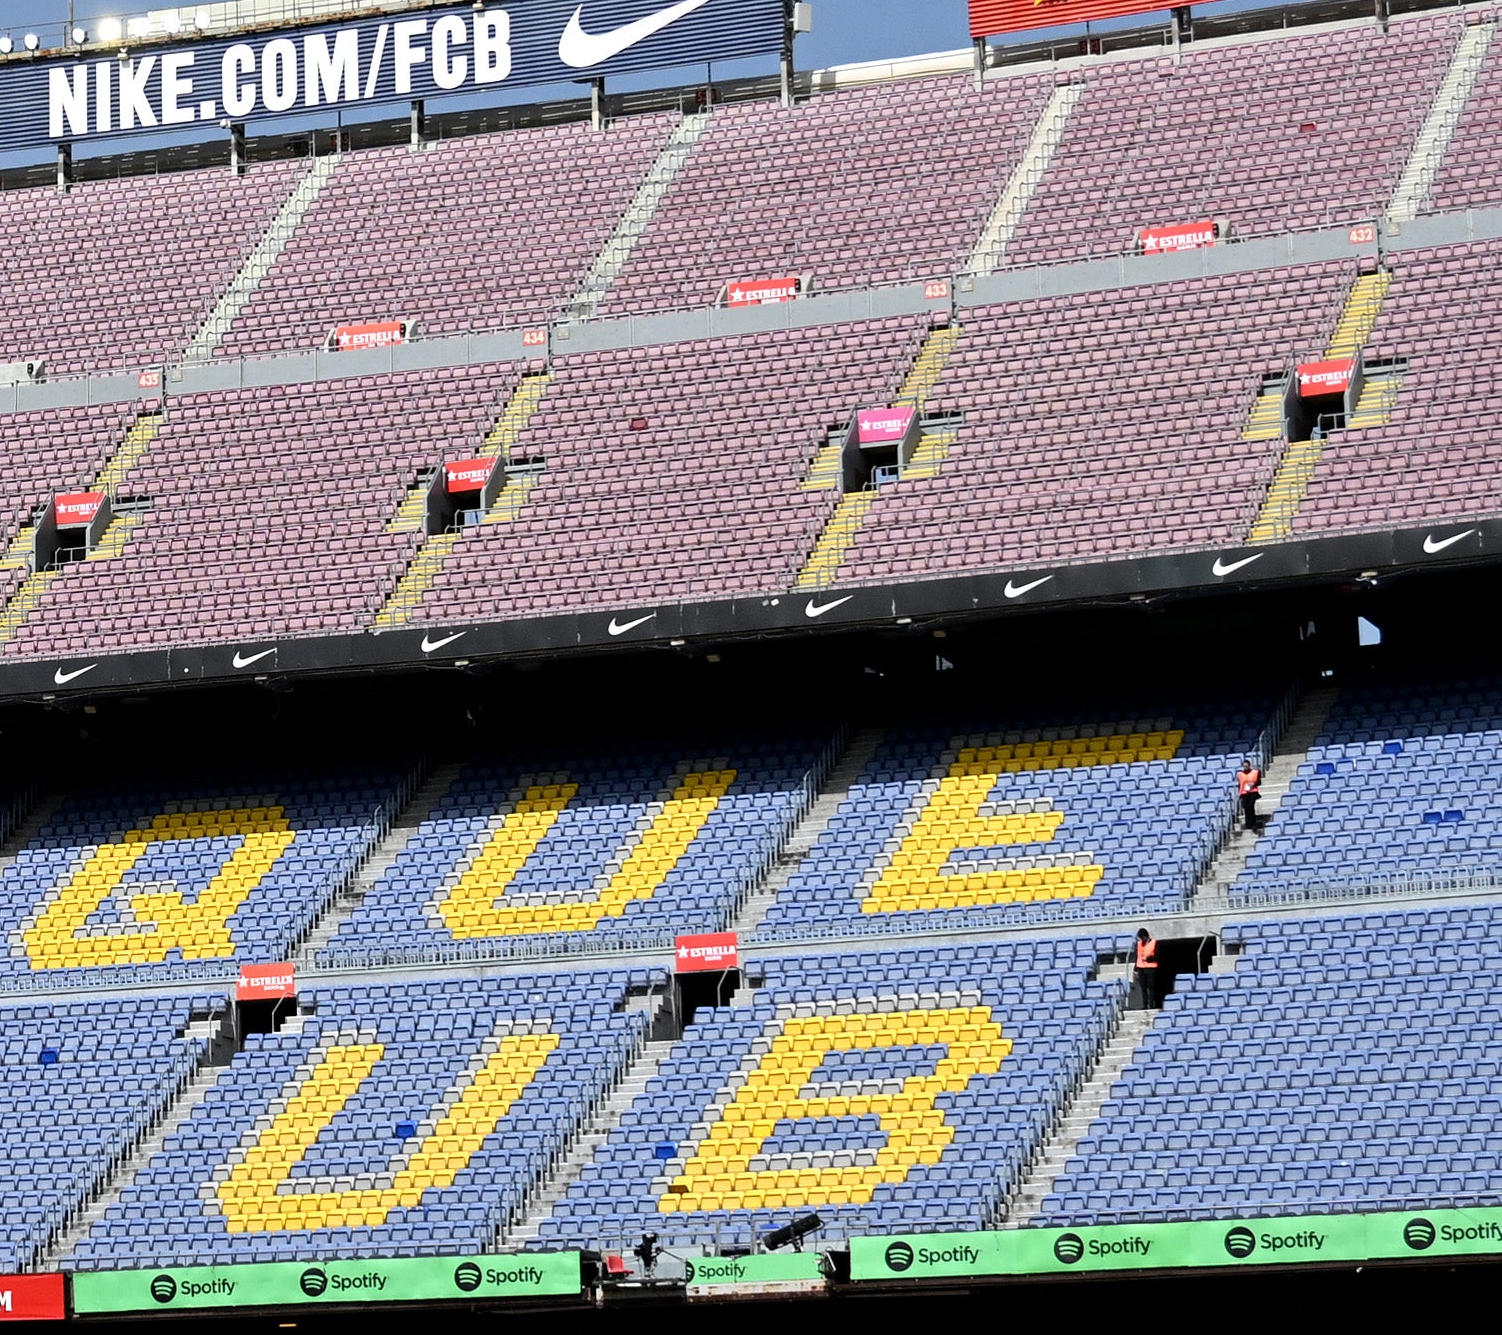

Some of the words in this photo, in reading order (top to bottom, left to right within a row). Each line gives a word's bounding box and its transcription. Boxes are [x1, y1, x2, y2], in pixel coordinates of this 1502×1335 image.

[48, 9, 512, 138] NIKE.COM/FCB
[1159, 230, 1215, 245] ESTRELLA
[1350, 228, 1373, 242] 432
[925, 284, 947, 297] 433
[523, 331, 545, 344] 434
[140, 374, 158, 386] 435
[23, 730, 1185, 969] QUE
[690, 945, 737, 957] ESTRELLA
[250, 974, 293, 986] ESTRELLA
[1089, 1237, 1150, 1257] Spotify
[1261, 1231, 1325, 1251] Spotify
[919, 1246, 978, 1265] Spotify
[487, 1267, 542, 1285] Spotify
[698, 1264, 744, 1279] Spotify
[181, 1279, 235, 1297] Spotify
[332, 1273, 386, 1291] Spotify
